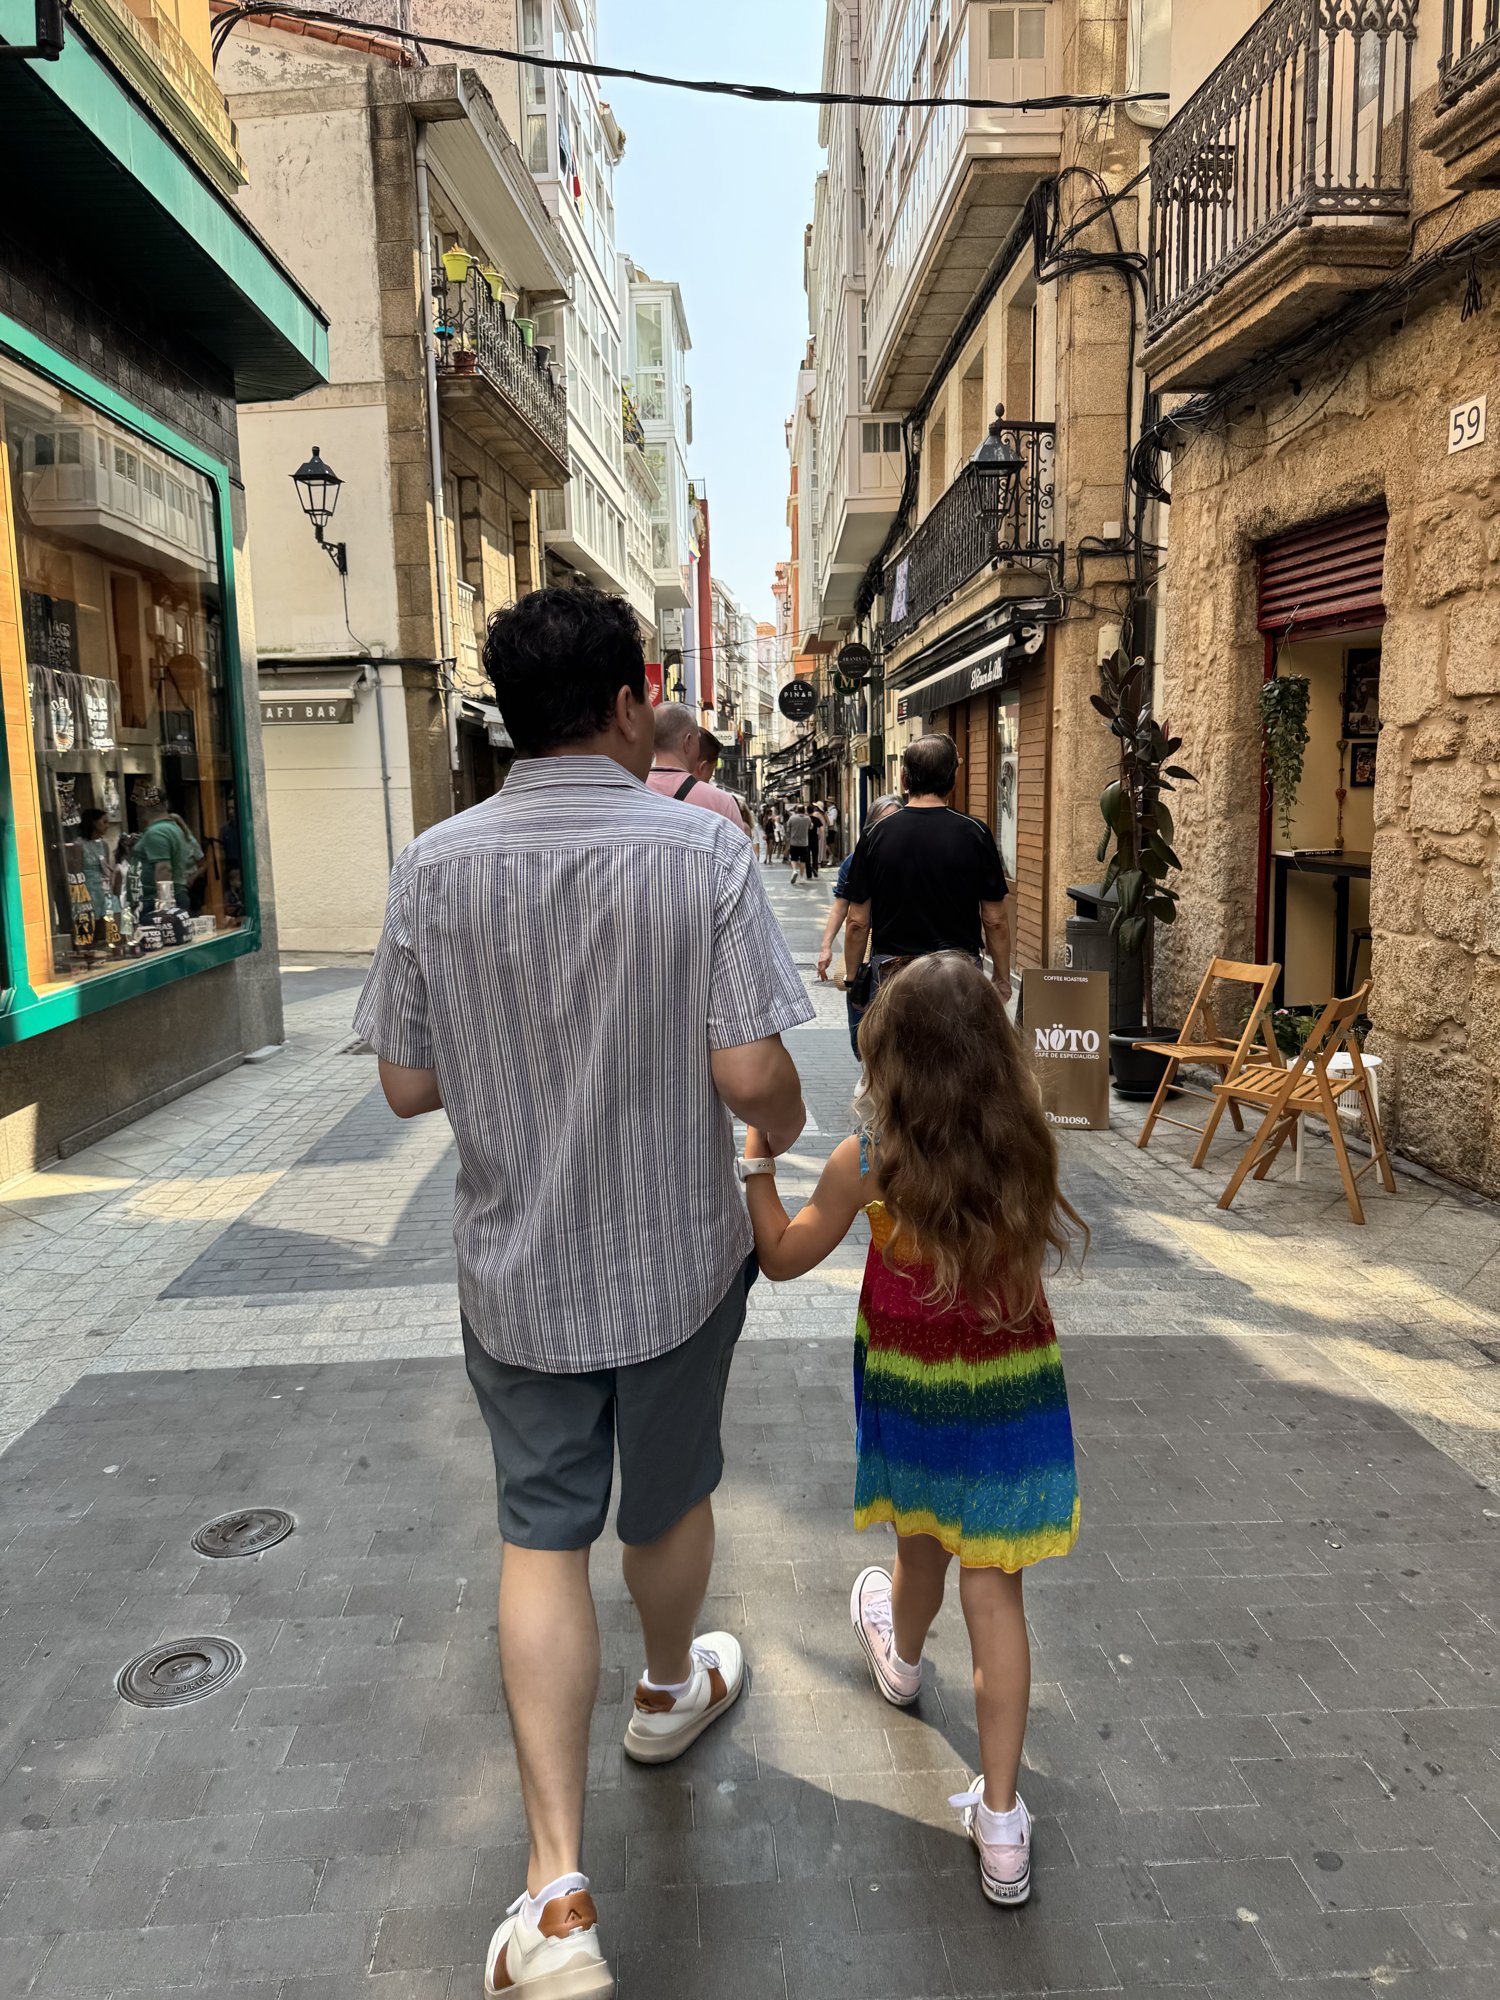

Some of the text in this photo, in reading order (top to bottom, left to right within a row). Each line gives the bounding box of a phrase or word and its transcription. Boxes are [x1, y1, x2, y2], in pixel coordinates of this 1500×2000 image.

[1453, 405, 1481, 446] 59
[840, 674, 855, 689] M
[266, 705, 337, 719] AFT BAR
[1034, 1023, 1100, 1052] NÖTO
